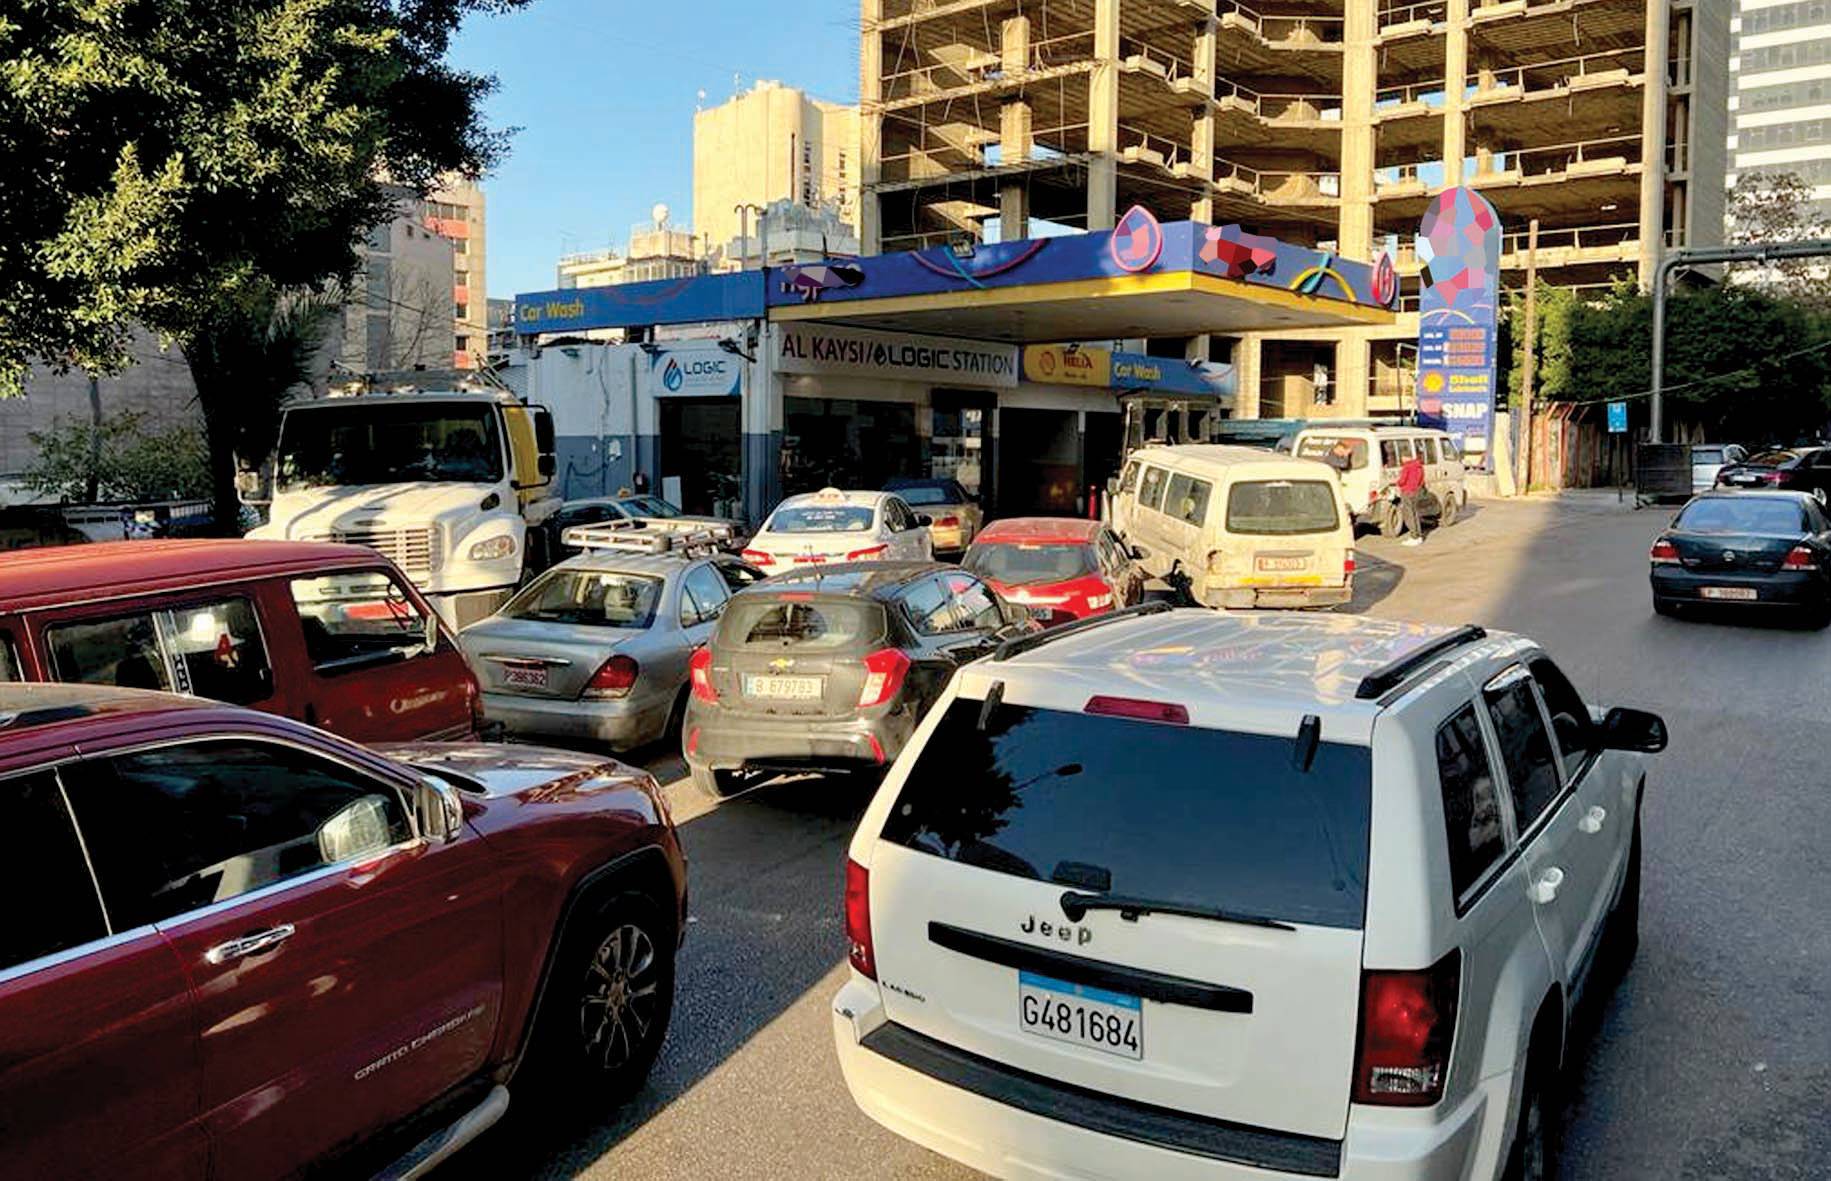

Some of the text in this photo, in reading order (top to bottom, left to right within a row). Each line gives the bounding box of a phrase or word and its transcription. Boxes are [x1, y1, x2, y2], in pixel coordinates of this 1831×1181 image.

[520, 297, 584, 322] Car Wash
[782, 334, 807, 358] AL
[888, 345, 949, 369] LOGIC
[953, 350, 1013, 374] STATION
[684, 360, 726, 375] LOGIC
[1114, 361, 1131, 378] Car
[1442, 402, 1489, 418] SNAP
[1021, 915, 1092, 946] Jeep
[1023, 995, 1138, 1051] G481684
